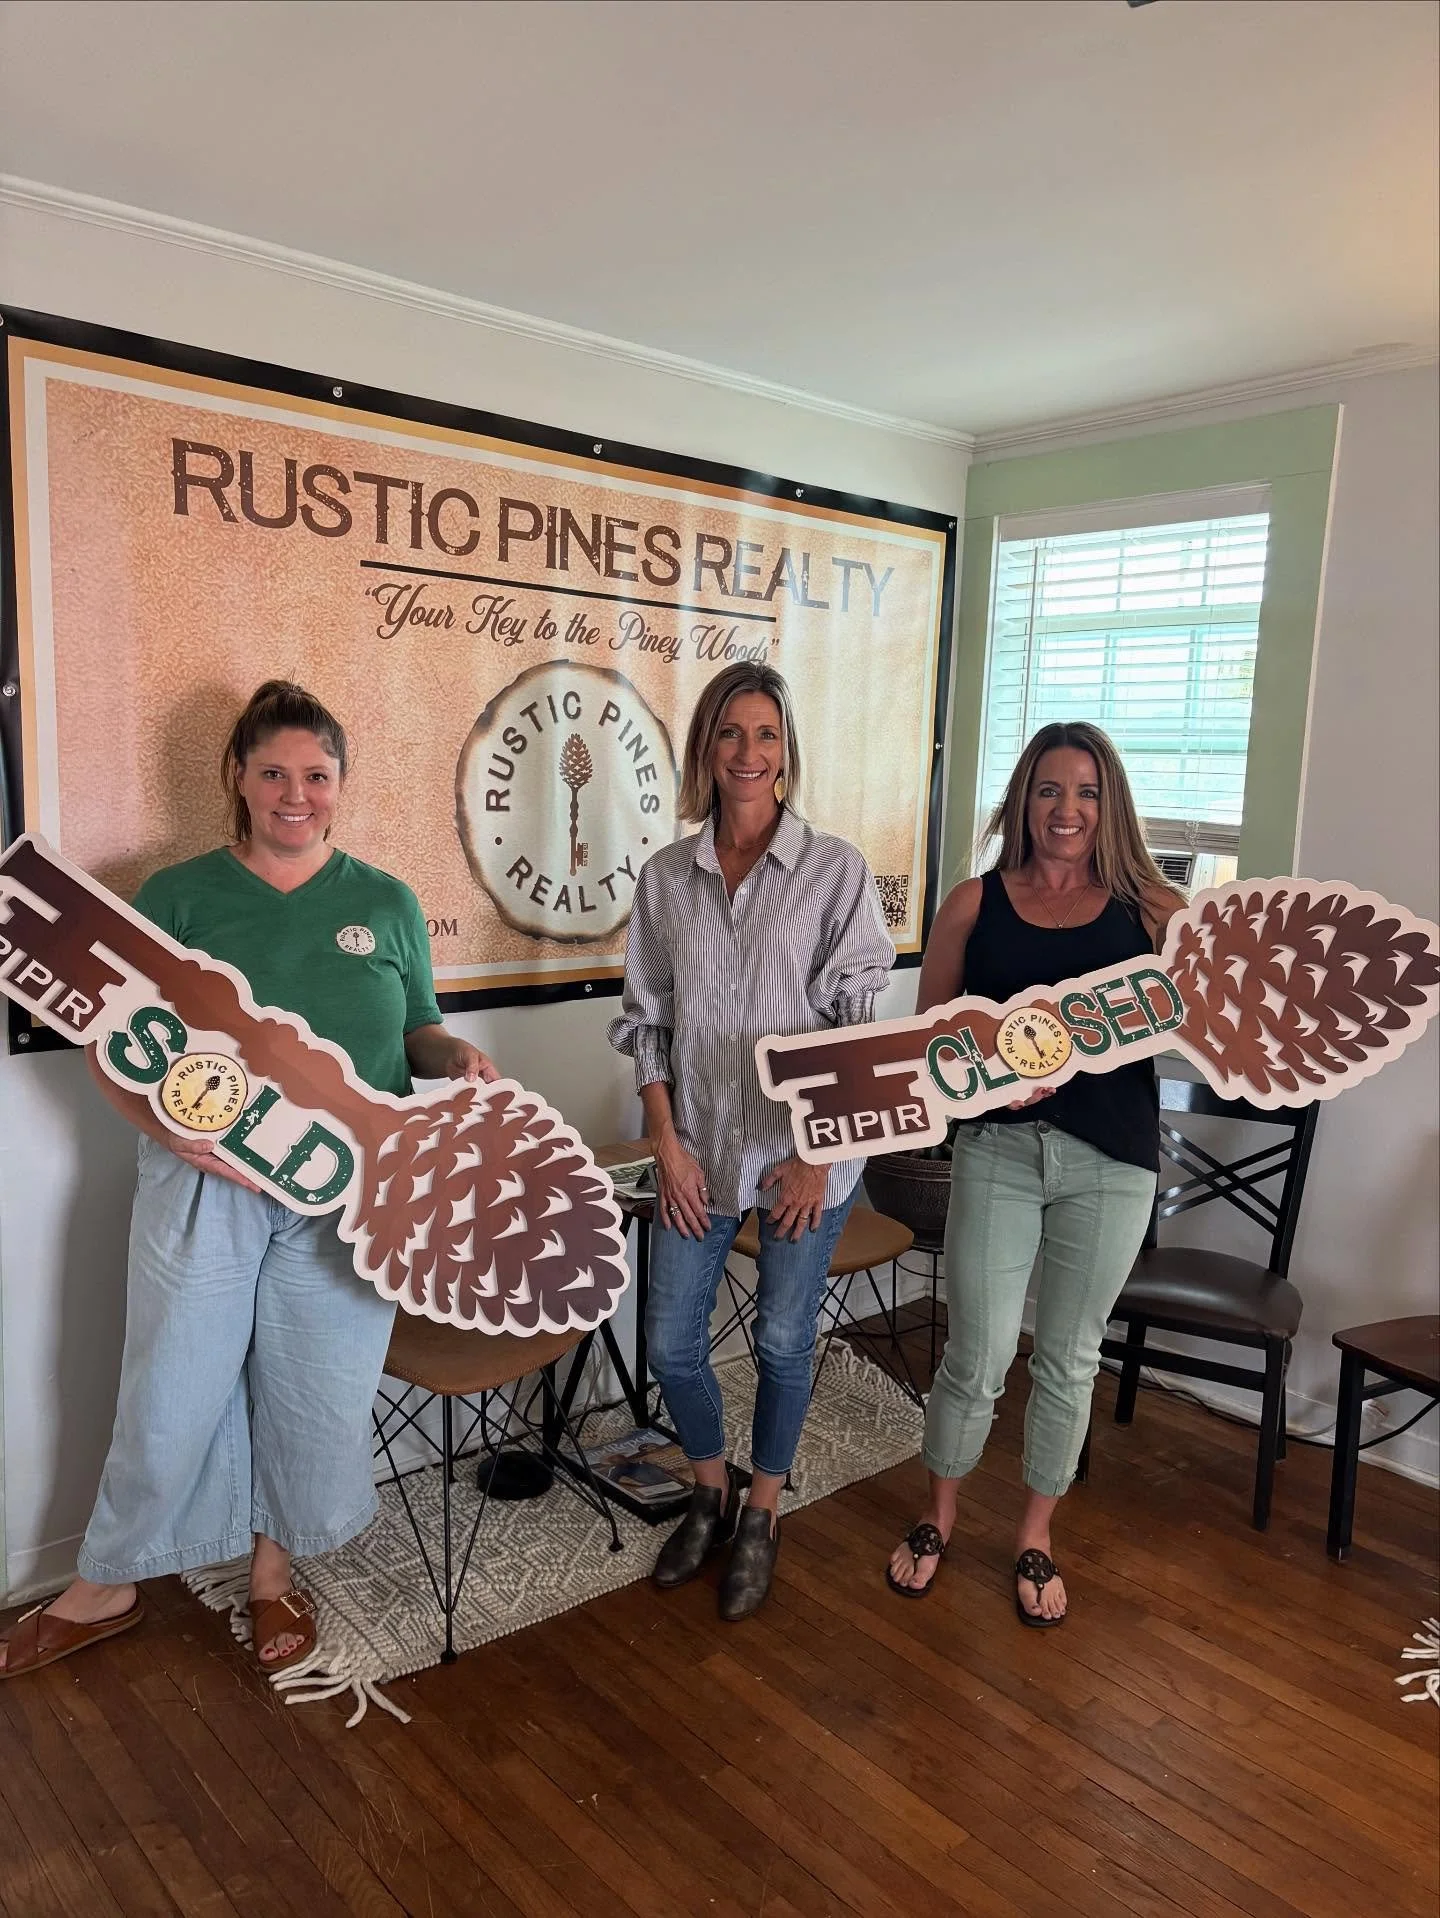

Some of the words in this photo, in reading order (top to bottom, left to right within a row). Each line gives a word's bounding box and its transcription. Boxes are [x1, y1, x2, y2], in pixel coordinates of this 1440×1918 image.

[171, 437, 481, 556] RUSTIC
[497, 496, 682, 587] PINES
[693, 531, 896, 617] REALTY
[364, 583, 457, 640] “Your
[465, 594, 528, 647] Key
[533, 608, 559, 639] to
[564, 612, 601, 645] the
[608, 610, 684, 664] Piney
[485, 690, 582, 813] RUSTIC
[598, 700, 661, 815] PINES
[505, 854, 638, 914] REALTY
[1005, 1016, 1026, 1054] RUSTIC
[1030, 1014, 1062, 1038] PINES
[1019, 1046, 1064, 1070] REALTY
[171, 1089, 215, 1124] REALTY
[177, 1060, 228, 1080] RUSTIC
[223, 1075, 240, 1113] PINES
